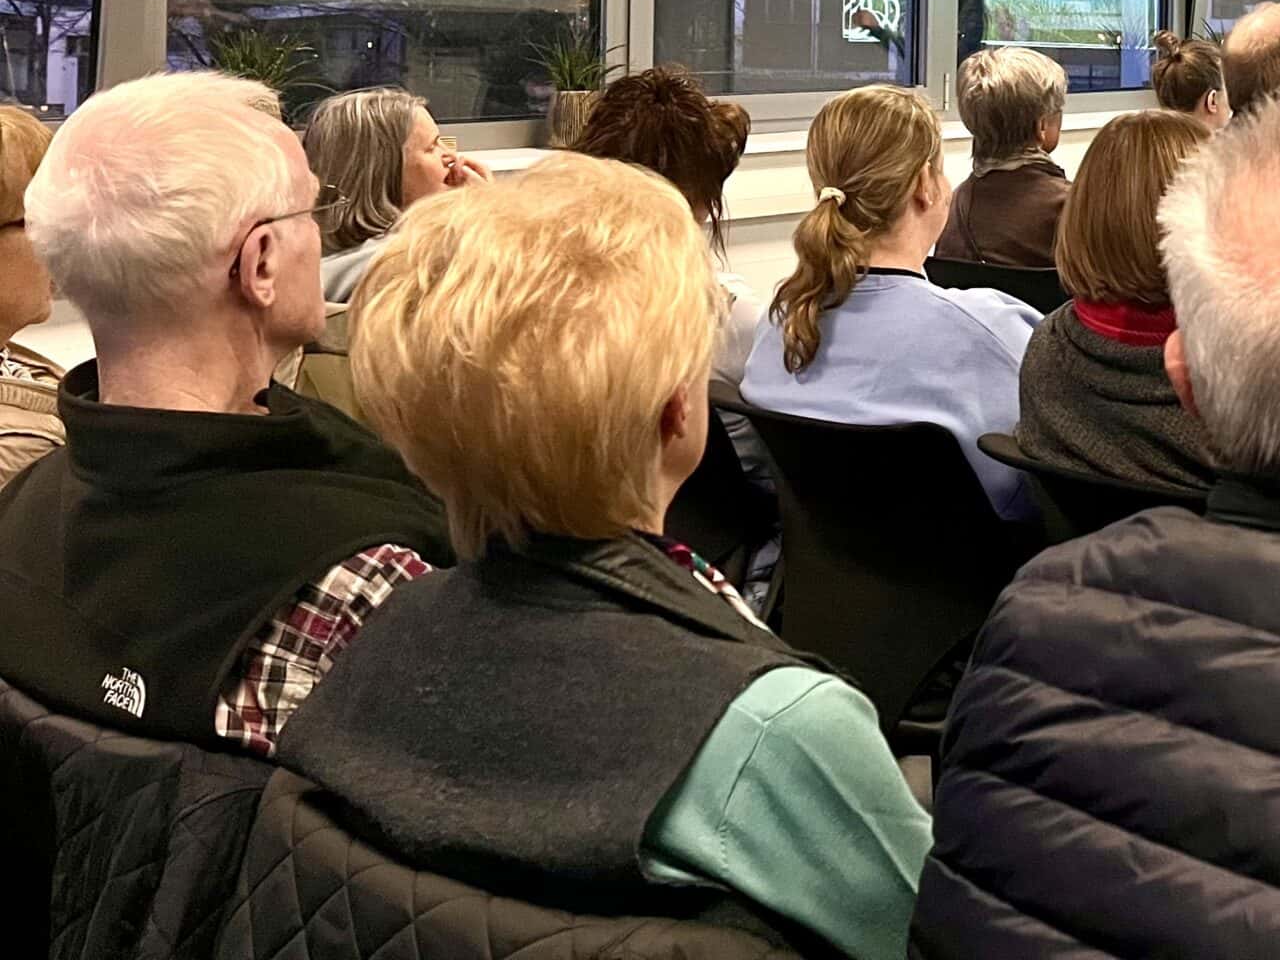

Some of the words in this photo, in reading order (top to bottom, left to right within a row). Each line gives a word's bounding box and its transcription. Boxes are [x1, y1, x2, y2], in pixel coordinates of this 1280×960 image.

[101, 673, 136, 698] NORTH
[122, 667, 138, 684] THE
[103, 689, 130, 710] FACE
